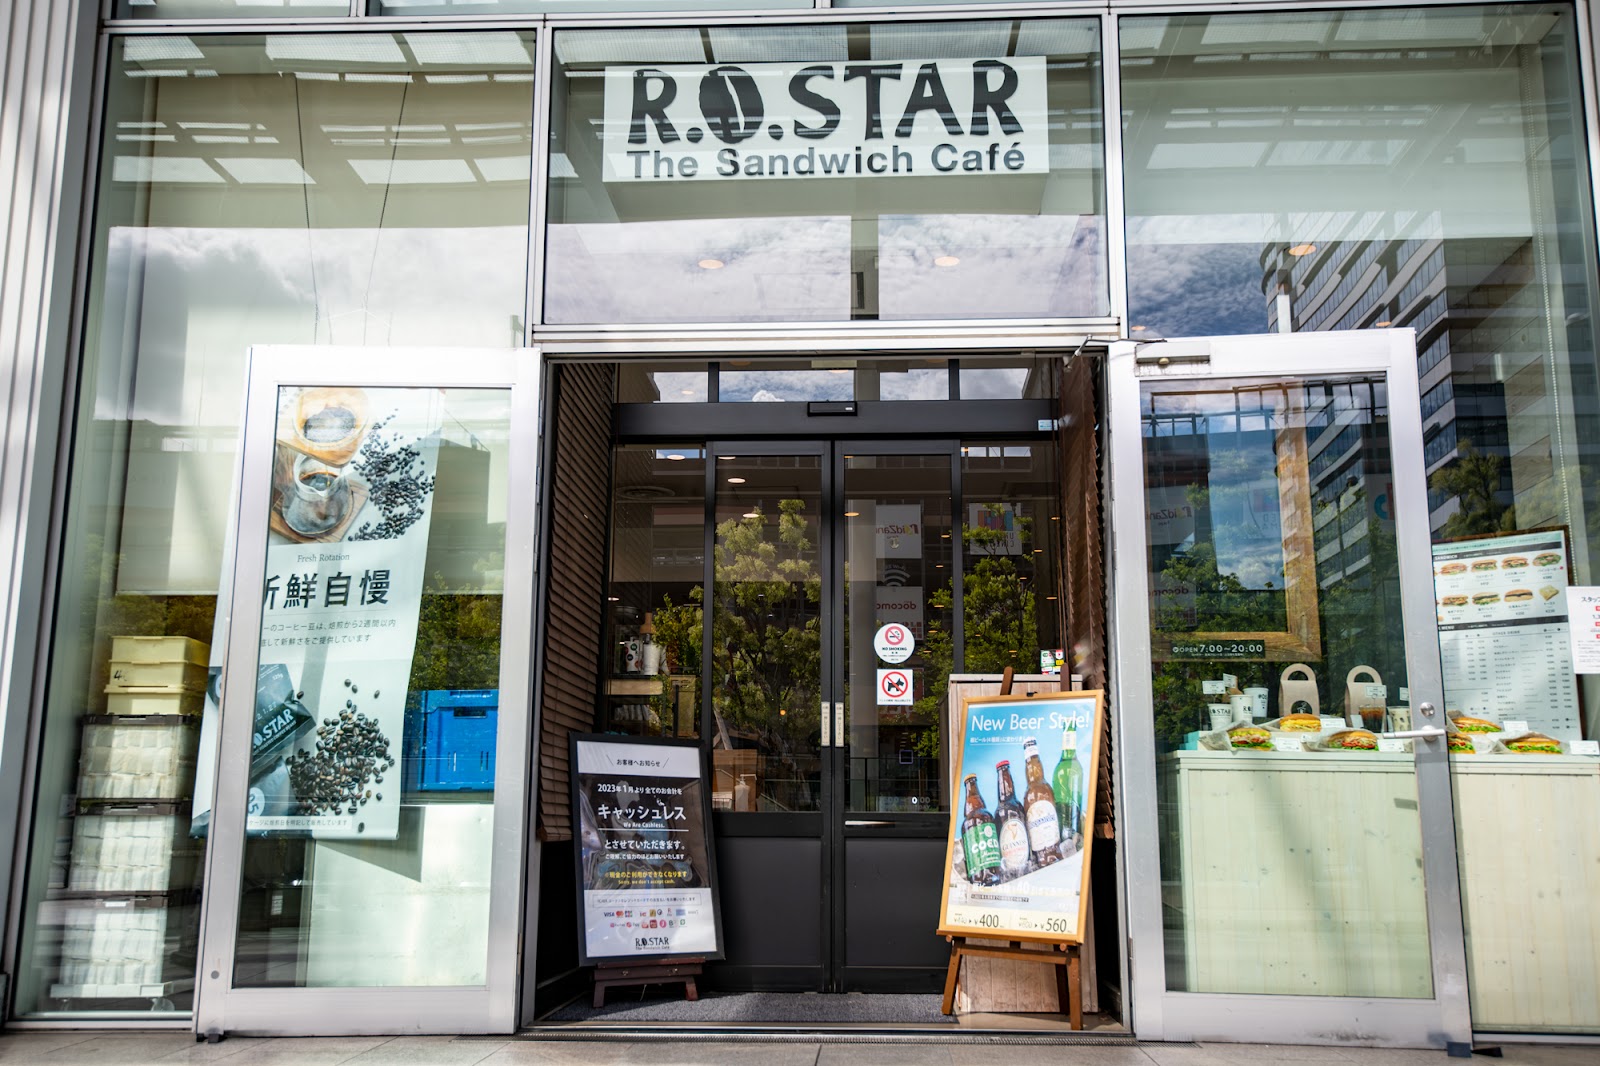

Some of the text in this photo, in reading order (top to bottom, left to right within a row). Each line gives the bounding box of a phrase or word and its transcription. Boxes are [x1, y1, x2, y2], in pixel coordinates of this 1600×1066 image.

[627, 59, 1025, 145] R.O.STAR
[627, 142, 1025, 179] The Sandwich Café
[297, 553, 350, 562] Fresh Rotation
[253, 708, 294, 749] .O.STAR
[971, 711, 1090, 732] New Beer Style!
[616, 759, 661, 767] お客様へお知らせ
[597, 804, 687, 820] キャッシュレス
[604, 840, 685, 850] とさせていただきます。
[635, 937, 669, 946] R.O.STAR
